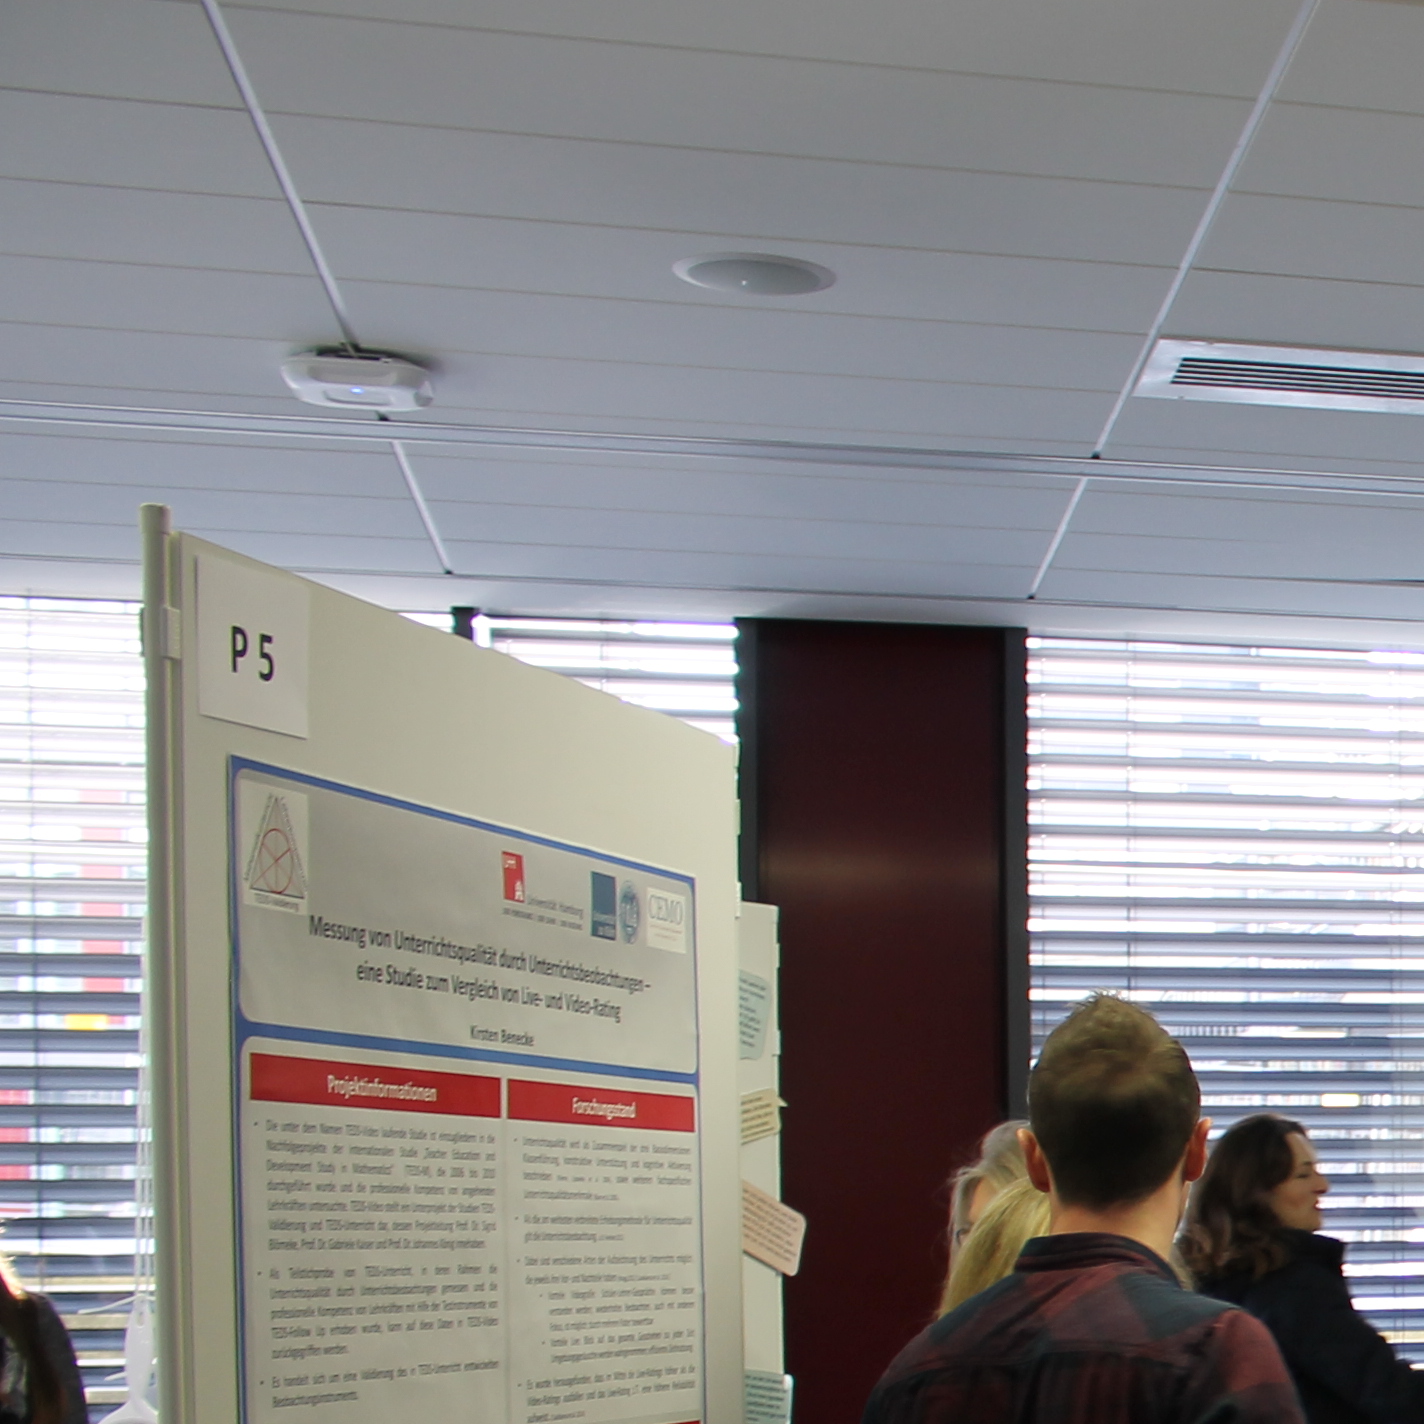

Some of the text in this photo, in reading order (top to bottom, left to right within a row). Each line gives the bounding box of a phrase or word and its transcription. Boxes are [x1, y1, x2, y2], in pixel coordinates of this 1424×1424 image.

[230, 626, 275, 682] P 5
[649, 894, 684, 926] CEMO
[308, 915, 366, 947] Messung
[368, 930, 391, 946] von
[394, 932, 497, 964] Unterrichtsqualität
[498, 949, 526, 970] durch
[528, 956, 643, 992] Unterrichtsbeobachtungen
[356, 962, 620, 1022] eine Studie zum Vergleich von Live- und Video-Rating
[327, 1075, 437, 1102] Projektinformationen
[572, 1097, 637, 1120] Forschungsstand
